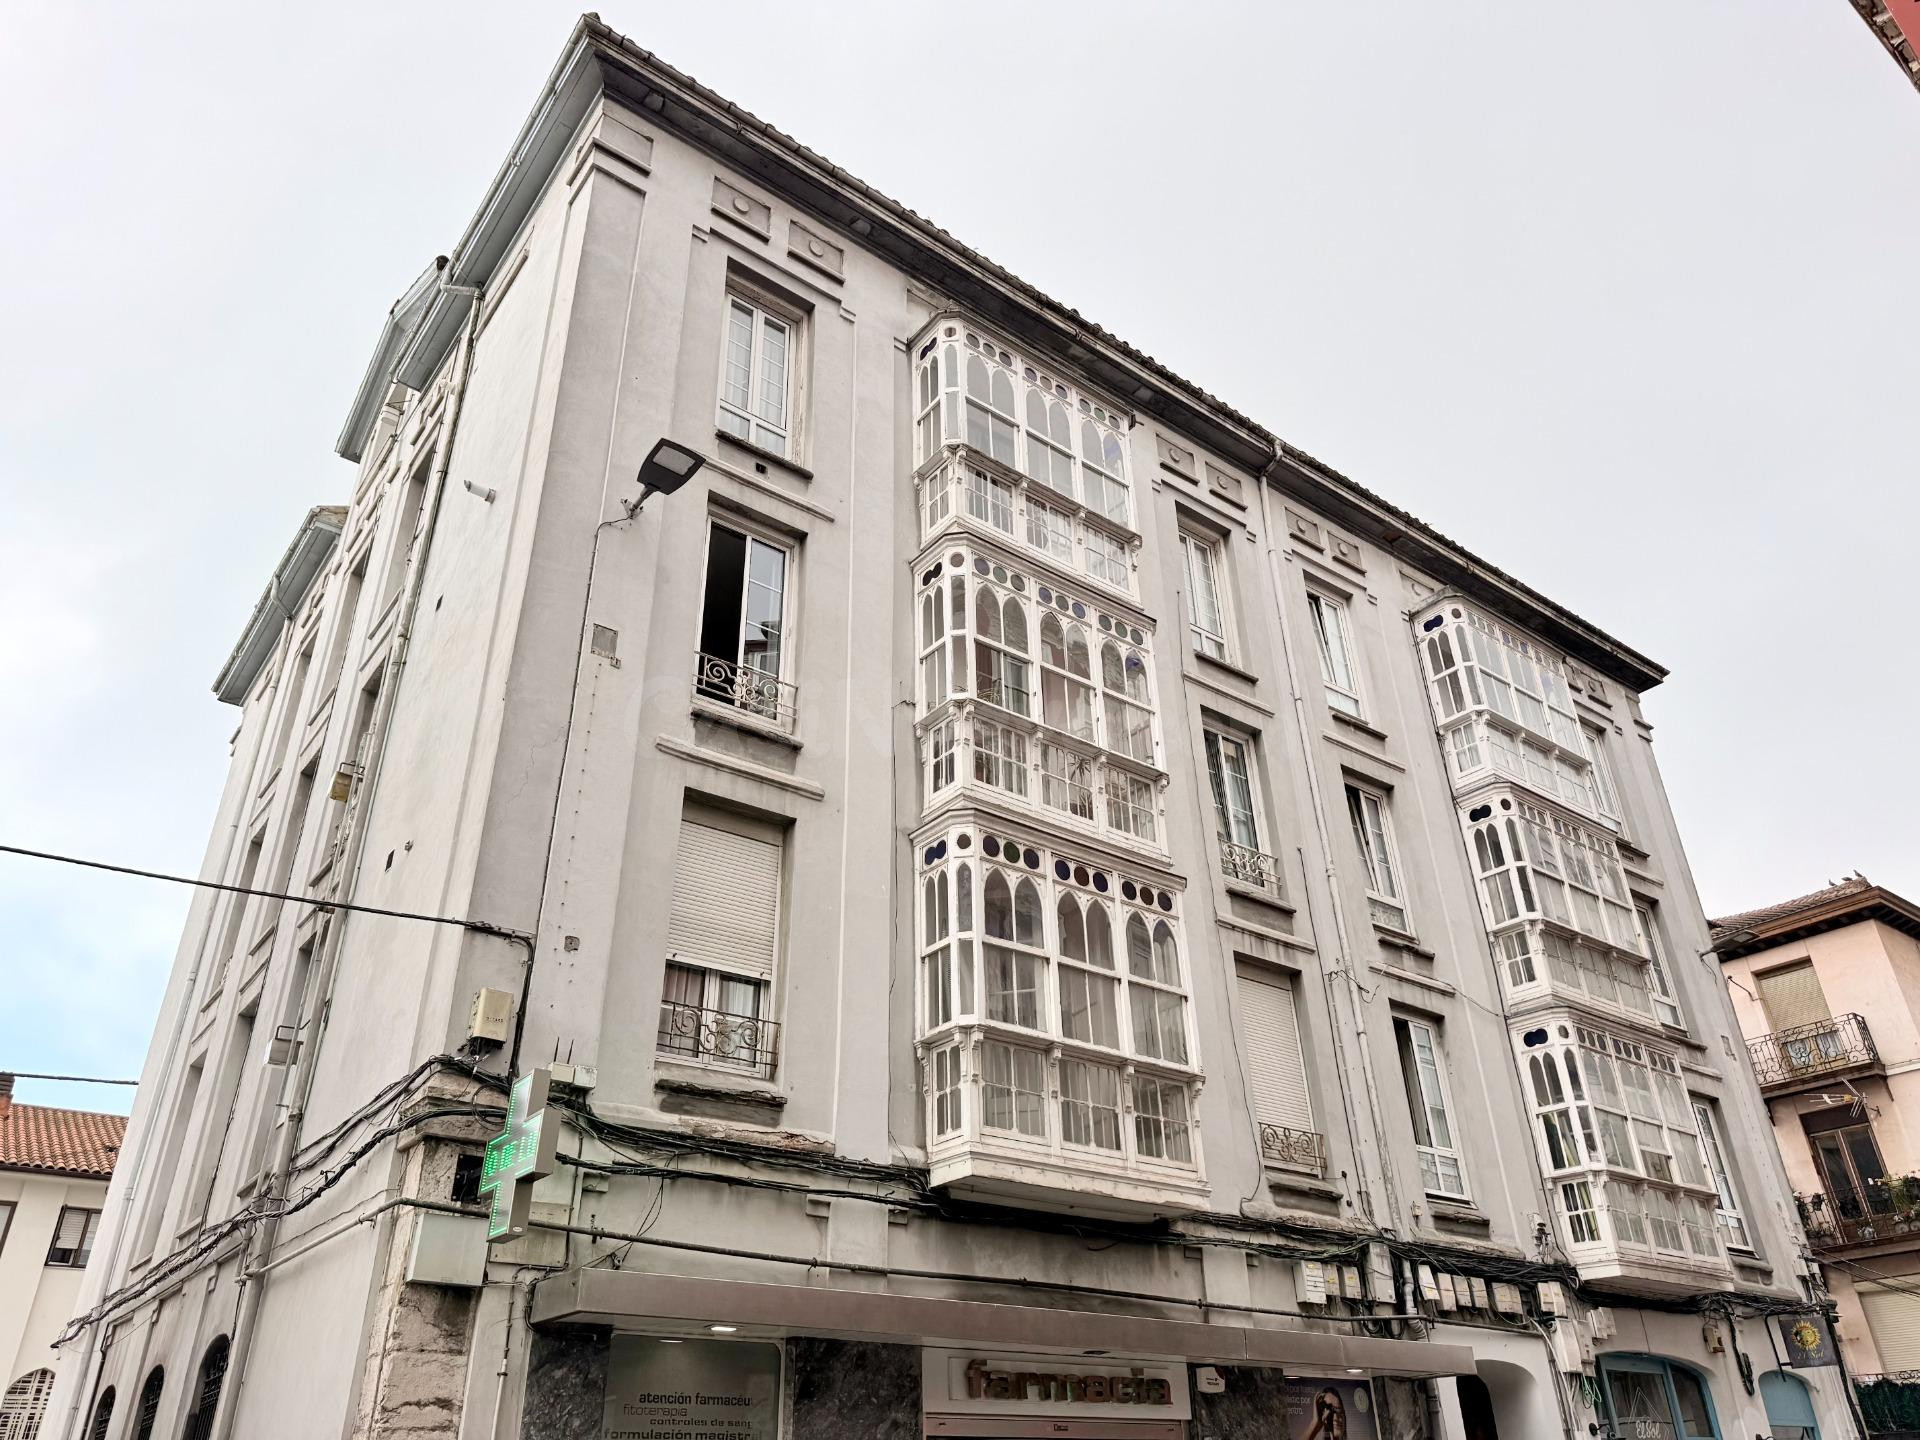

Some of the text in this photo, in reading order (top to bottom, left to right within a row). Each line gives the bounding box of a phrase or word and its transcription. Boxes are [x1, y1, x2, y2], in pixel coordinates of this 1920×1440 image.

[966, 1359, 1173, 1405] farmacia
[639, 1391, 752, 1406] atención farmacéu
[623, 1403, 688, 1417] fitoterapia
[650, 1418, 707, 1427] controles
[710, 1418, 724, 1427] de
[605, 1429, 692, 1440] formulación
